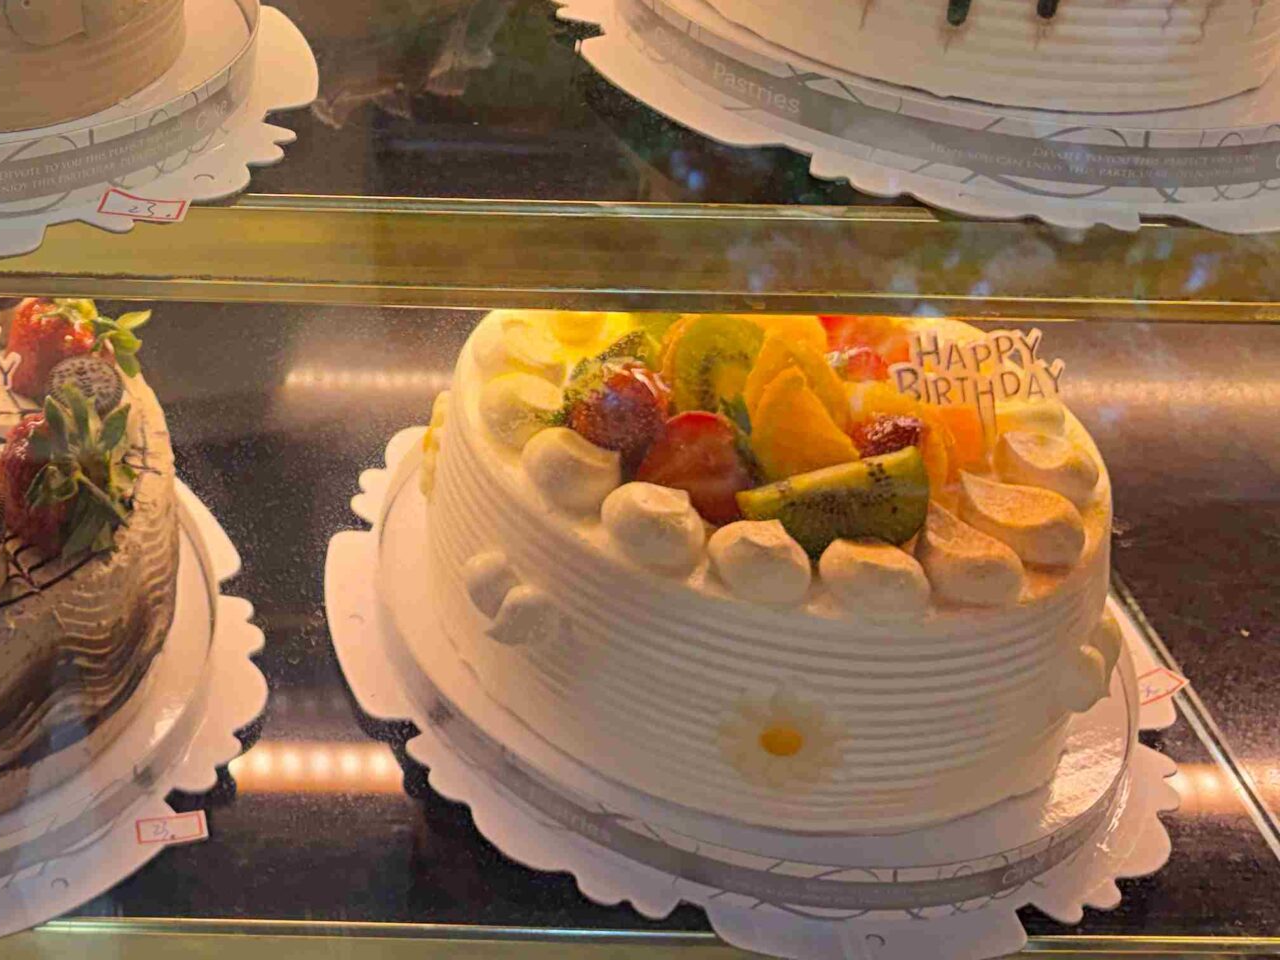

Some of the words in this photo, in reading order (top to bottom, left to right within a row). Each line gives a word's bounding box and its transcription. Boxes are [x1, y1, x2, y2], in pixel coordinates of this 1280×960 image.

[711, 61, 801, 114] Pastries
[915, 333, 1039, 373] HAPPY
[895, 364, 1064, 422] BIRTHDAY
